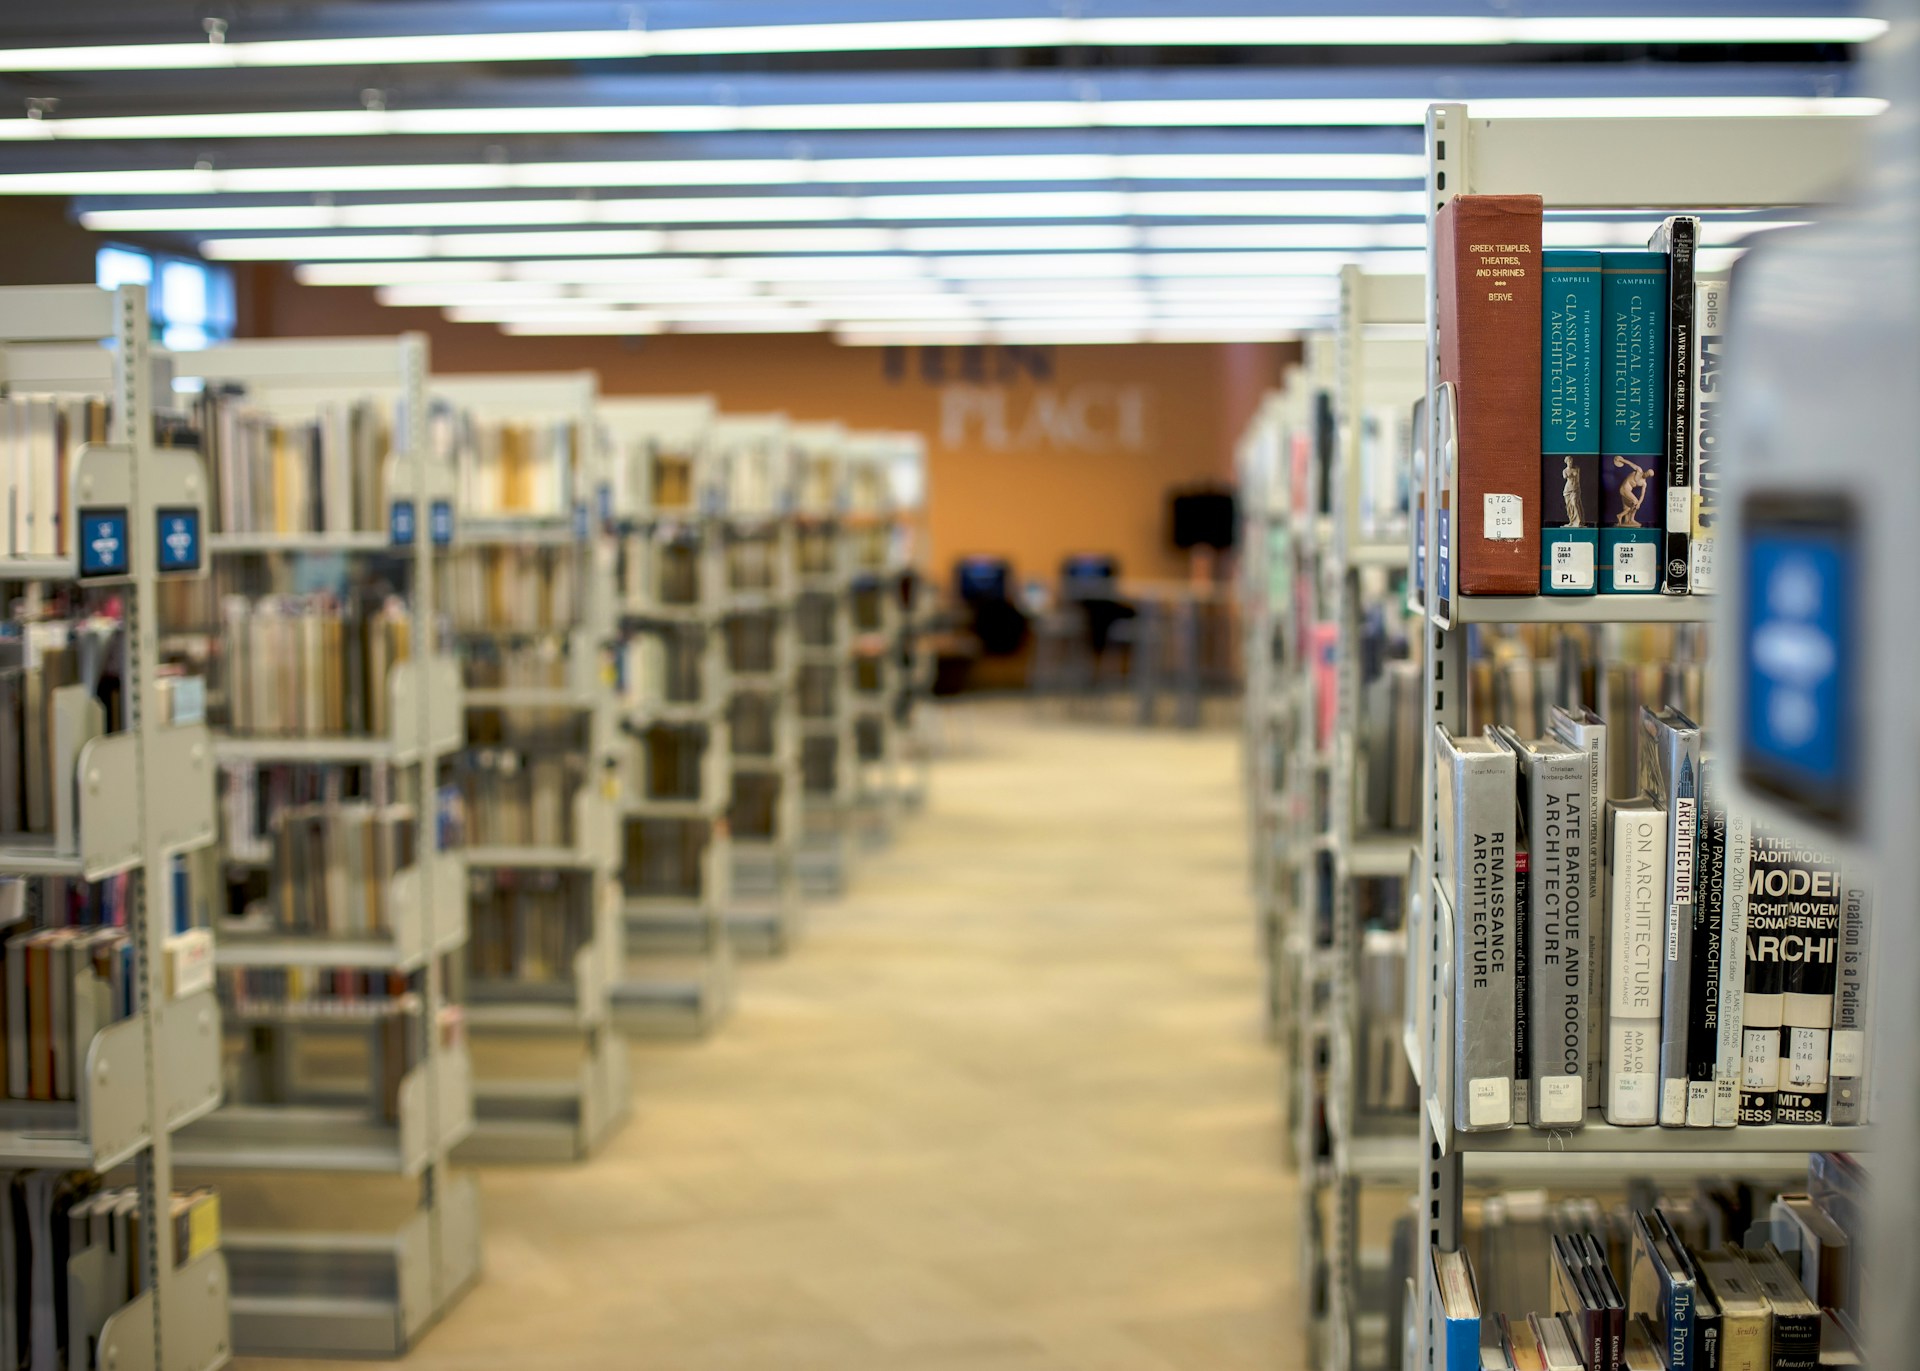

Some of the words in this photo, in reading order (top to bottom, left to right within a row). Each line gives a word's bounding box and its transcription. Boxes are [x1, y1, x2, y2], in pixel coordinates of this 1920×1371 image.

[1470, 244, 1494, 252] GREEK
[1495, 244, 1531, 254] TEMPLES,
[1480, 256, 1520, 266] THEATRES,
[1488, 293, 1513, 301] BERVE
[1707, 292, 1718, 328] Bolles
[1566, 294, 1577, 370] CLASSICAL
[1630, 296, 1642, 372] CLASSICAL
[1678, 325, 1686, 378] LAWRENCE:
[1552, 311, 1562, 425] ARCHITECTURE
[1616, 312, 1627, 426] ARCHITECTURE
[1566, 376, 1577, 404] ART
[1630, 376, 1641, 405] ART
[1677, 380, 1685, 411] GREEK
[1566, 409, 1577, 442] AND
[1584, 418, 1590, 428] OF
[1630, 410, 1640, 443] AND
[1648, 420, 1654, 430] OF
[1676, 414, 1684, 486] ARCHITECTURE
[1631, 534, 1636, 542] 2
[1561, 574, 1576, 583] PL
[1625, 574, 1639, 583] PL
[1704, 781, 1712, 797] The
[1566, 793, 1580, 838] LATE
[1700, 801, 1710, 839] Language
[1714, 810, 1724, 842] NEW
[1591, 847, 1596, 856] OF
[1638, 823, 1652, 852] ON
[1676, 801, 1692, 901] ARCHITECTURE
[1701, 842, 1709, 852] of
[1735, 834, 1745, 844] of
[1766, 838, 1791, 848] THE
[1734, 848, 1744, 864] the
[1517, 879, 1525, 896] The
[1545, 794, 1560, 964] ARCHITECTURE
[1566, 847, 1579, 940] BAROQUE
[1699, 854, 1709, 923] Post-Modernism
[1710, 846, 1723, 912] PARADIGM
[1732, 868, 1744, 890] 20th
[1474, 834, 1487, 988] ARCHITECTURE
[1492, 832, 1504, 972] RENAISSANCE
[1729, 895, 1743, 933] Century
[1846, 889, 1864, 945] Creation
[1517, 898, 1525, 948] Architecture
[1625, 912, 1630, 923] ON
[1710, 916, 1720, 929] IN
[1634, 860, 1652, 1007] ARCHITECTURE
[1517, 949, 1525, 959] of
[1517, 960, 1525, 973] the
[1565, 947, 1579, 987] AND
[1845, 952, 1862, 963] is
[1705, 932, 1719, 1028] ARCHITECTURE
[1729, 961, 1737, 982] Edition
[1516, 976, 1525, 1018] Eighteenth
[1841, 982, 1860, 1028] Patient
[1516, 1020, 1525, 1054] Century
[1565, 994, 1578, 1074] ROCOCO
[1635, 1031, 1644, 1052] ADA
[1778, 1094, 1802, 1107] MIT
[1778, 1109, 1822, 1122] PRESS
[1675, 1294, 1689, 1321] The
[1736, 1327, 1758, 1336] Scully
[1673, 1328, 1688, 1366] Front
[1776, 1359, 1814, 1369] Monastery
